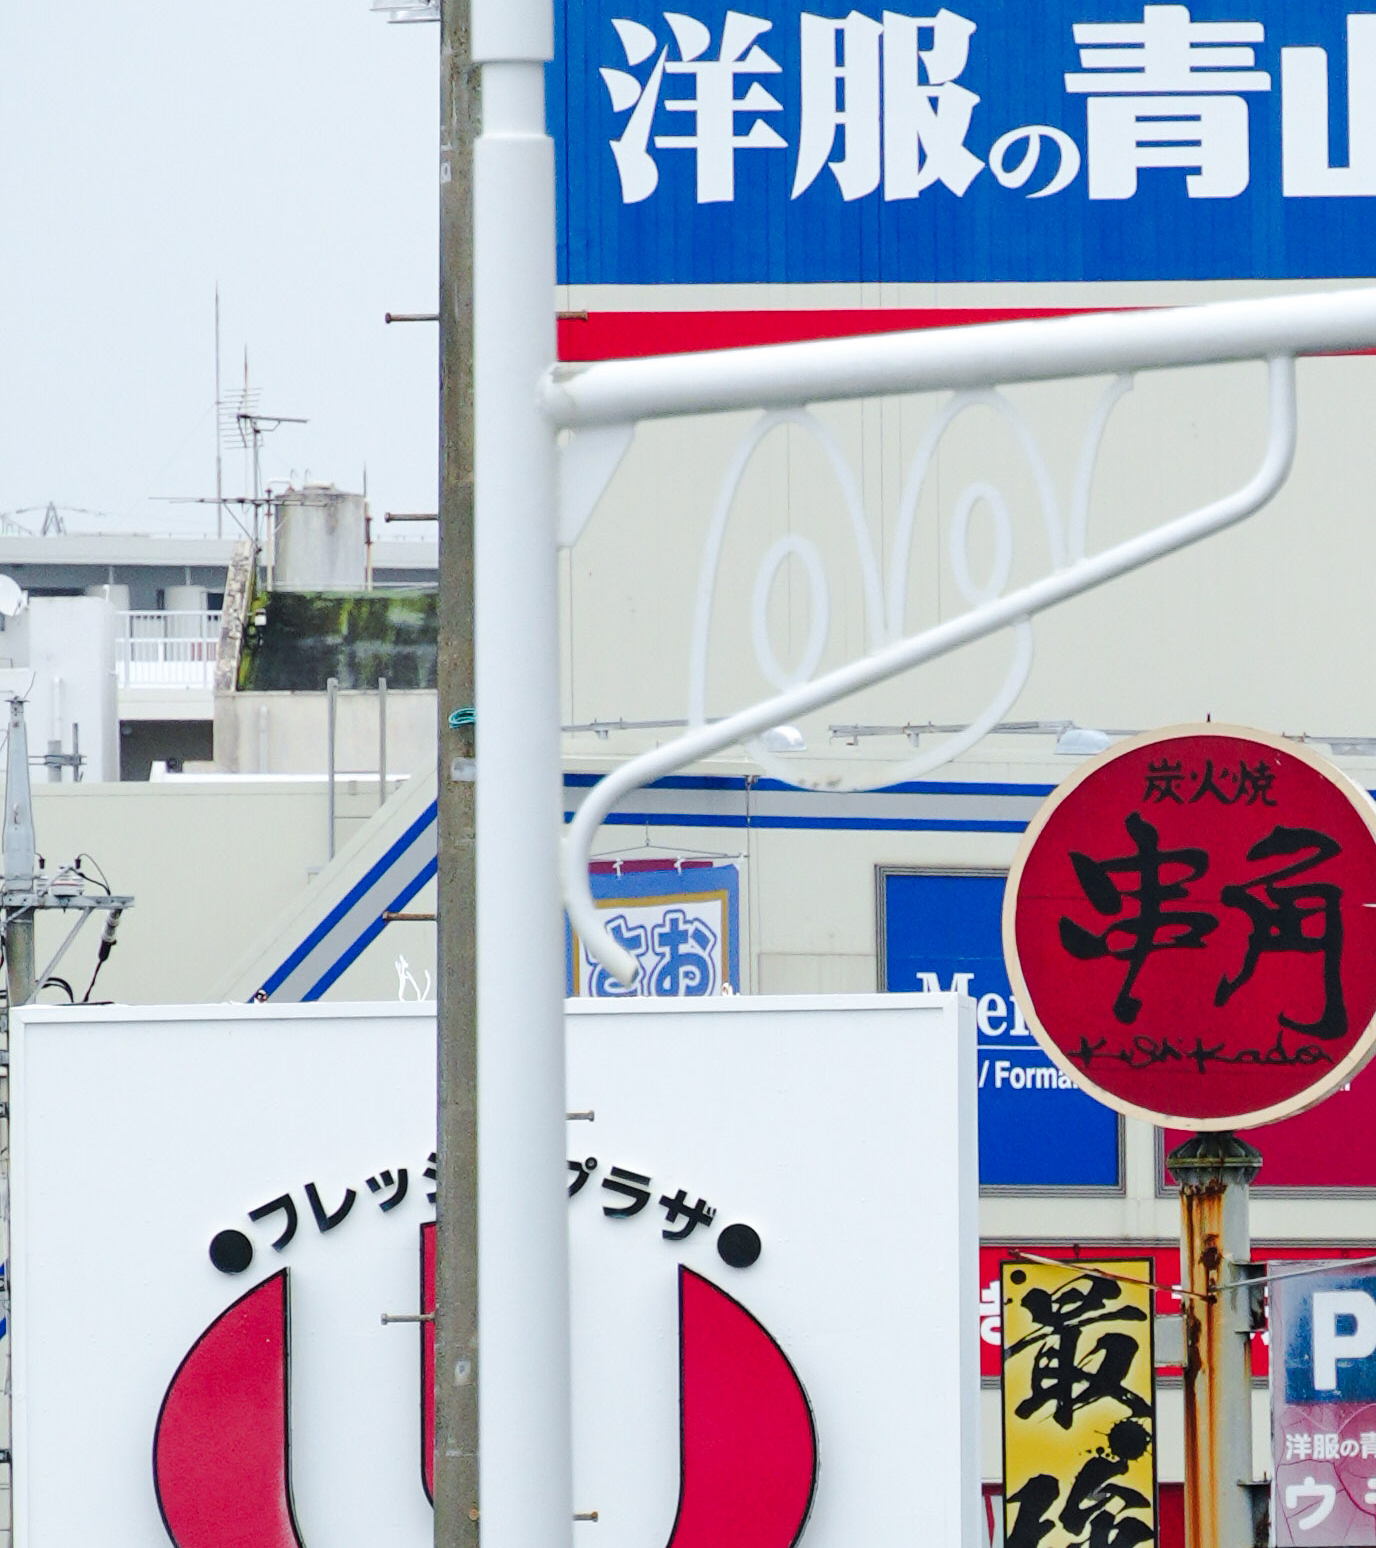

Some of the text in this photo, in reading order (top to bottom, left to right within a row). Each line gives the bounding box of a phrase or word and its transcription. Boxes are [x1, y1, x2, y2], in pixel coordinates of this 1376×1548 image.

[1144, 758, 1277, 807] 炭火焼
[1058, 811, 1348, 1040] 串角
